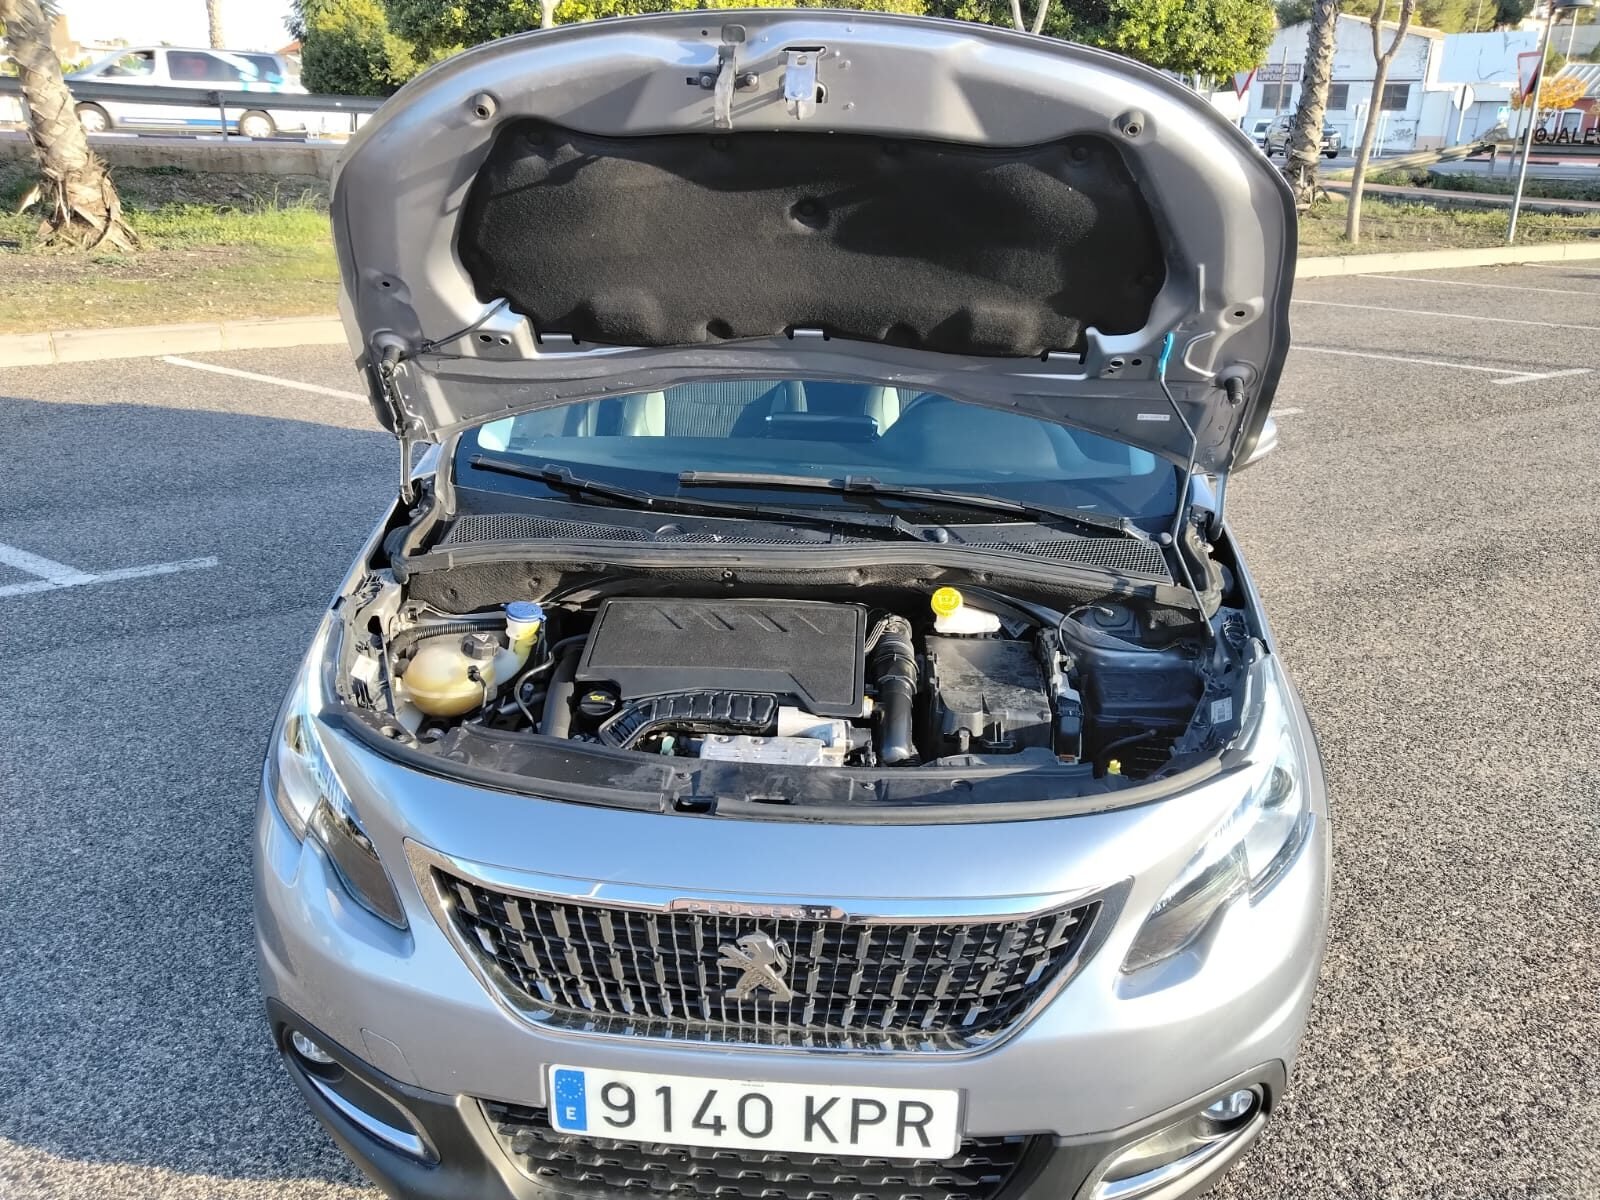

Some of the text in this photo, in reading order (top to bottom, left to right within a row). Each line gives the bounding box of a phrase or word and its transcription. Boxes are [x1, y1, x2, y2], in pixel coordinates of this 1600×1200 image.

[688, 902, 828, 920] PEUGEOT
[566, 1106, 577, 1121] E
[600, 1080, 934, 1148] 9140 KPR
